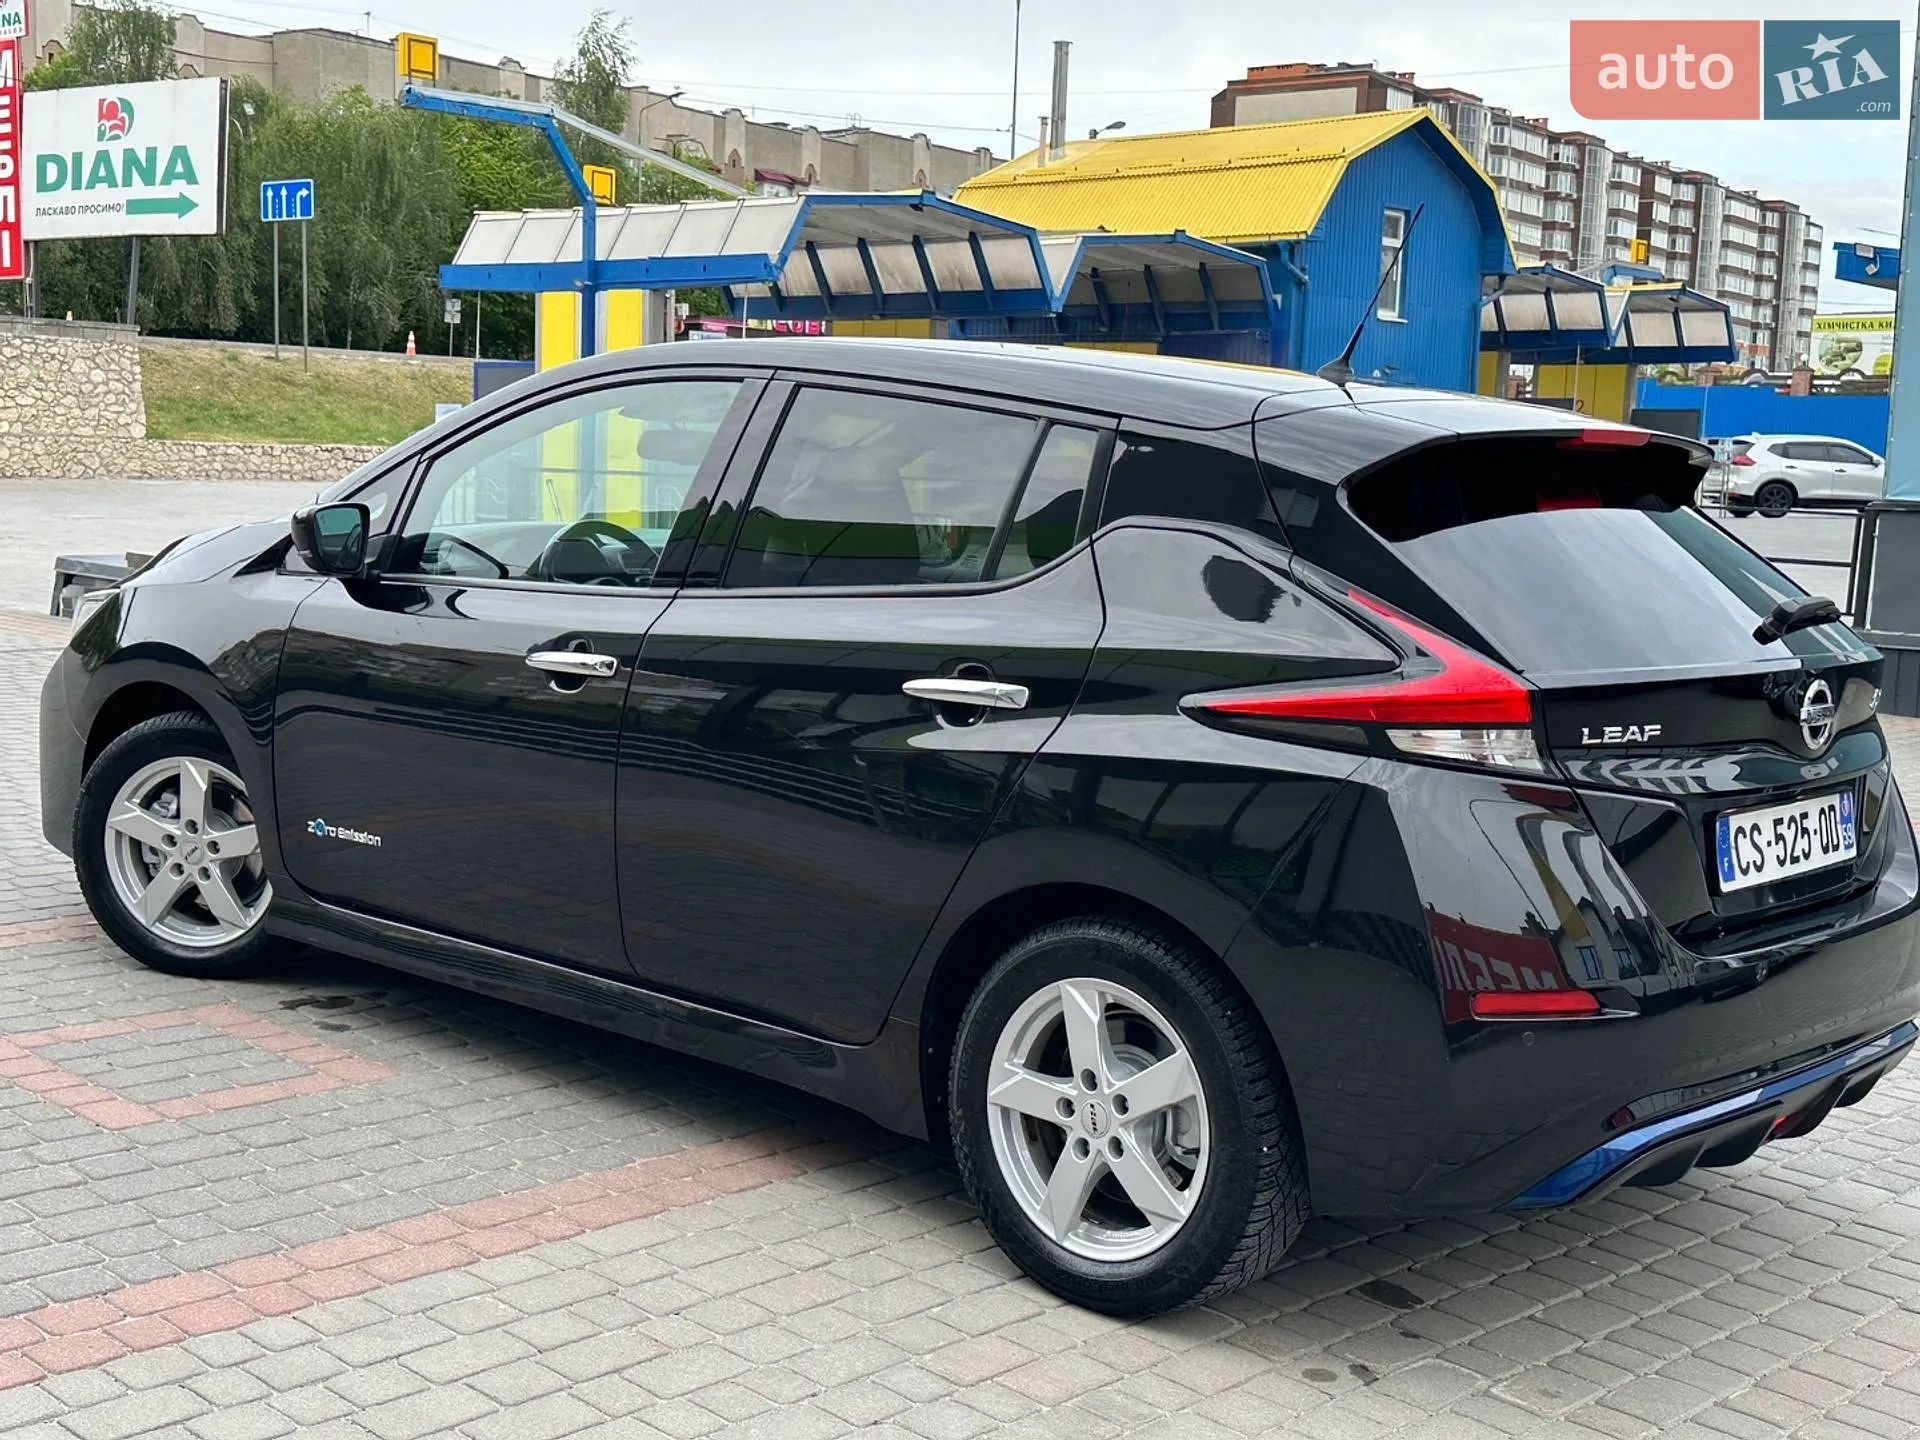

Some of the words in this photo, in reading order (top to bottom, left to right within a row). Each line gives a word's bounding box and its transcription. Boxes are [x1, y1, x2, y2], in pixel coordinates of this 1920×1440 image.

[36, 145, 199, 193] DIANA
[35, 206, 77, 217] ЛАСКАВО
[1816, 320, 1875, 330] ХІМЧИСТКА
[1581, 724, 1662, 745] LEAF
